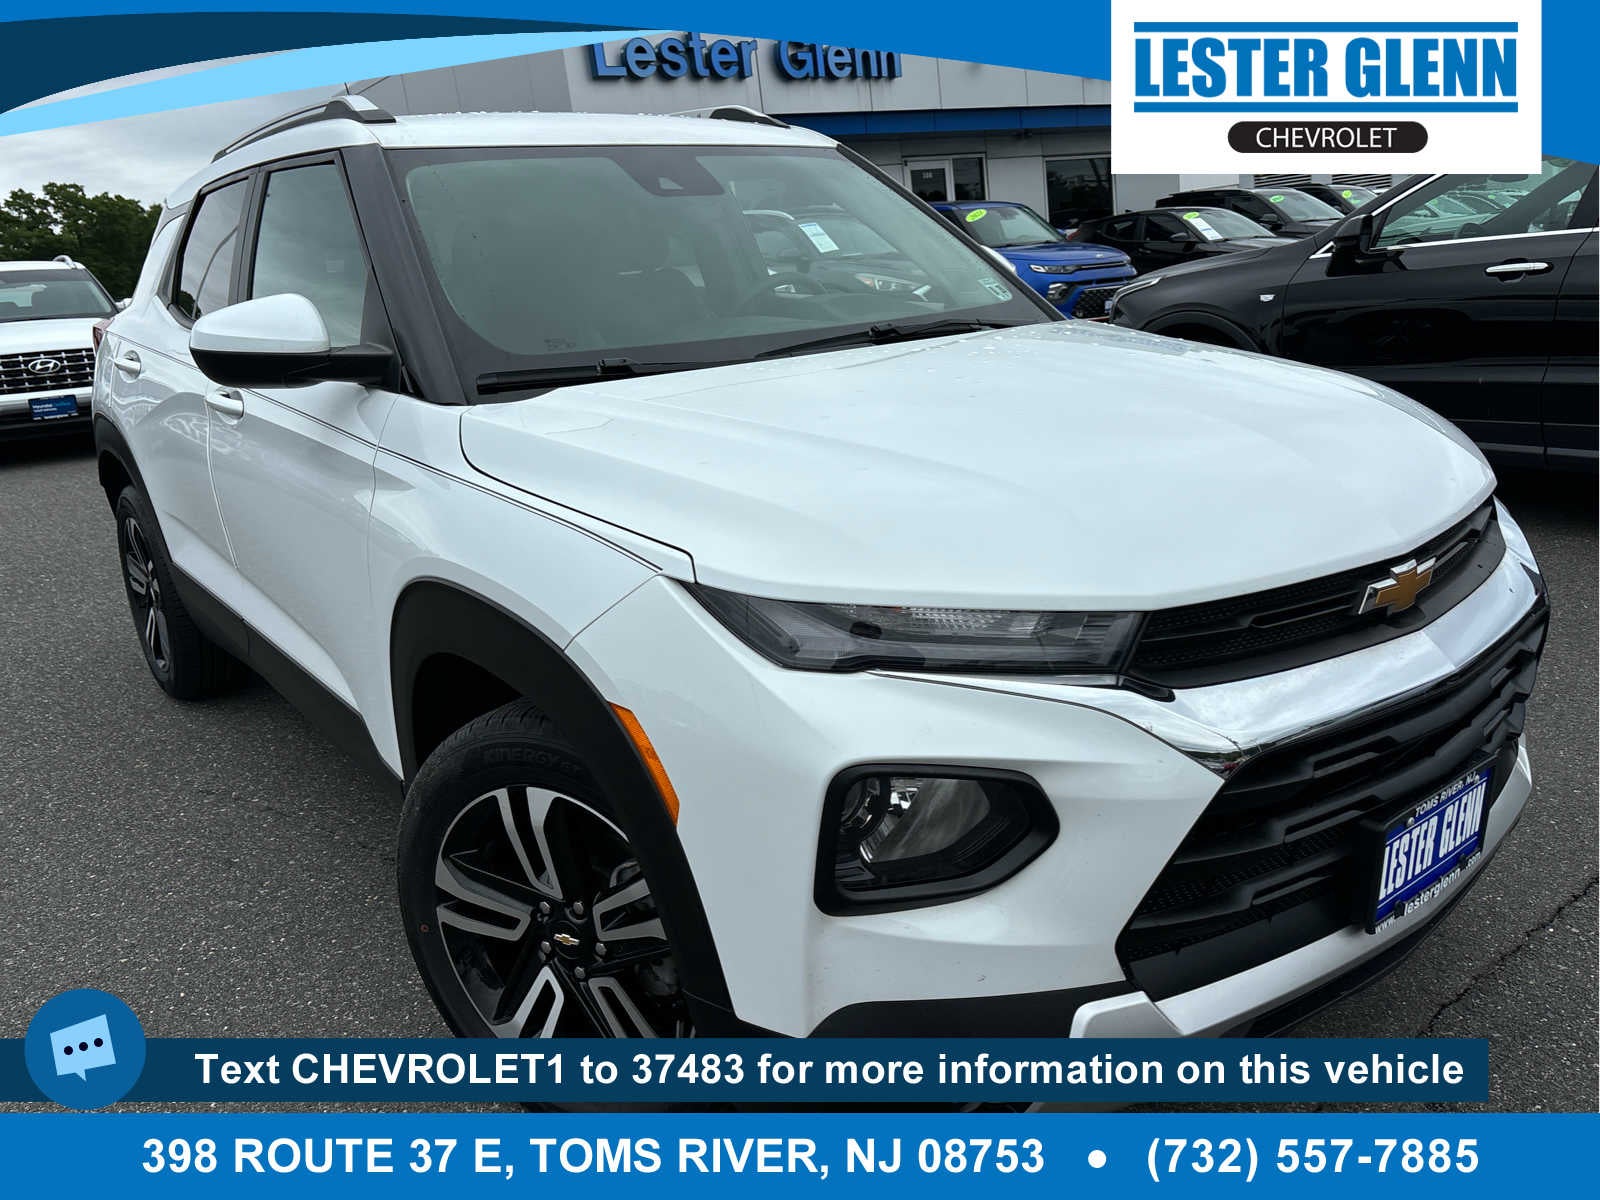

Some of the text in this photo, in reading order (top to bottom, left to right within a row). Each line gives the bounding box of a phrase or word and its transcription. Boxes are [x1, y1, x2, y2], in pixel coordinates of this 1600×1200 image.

[593, 32, 902, 79] Lester Glenn
[1415, 796, 1439, 817] TOMS
[1465, 771, 1477, 786] NJ
[1379, 783, 1487, 900] LESTER GLENN
